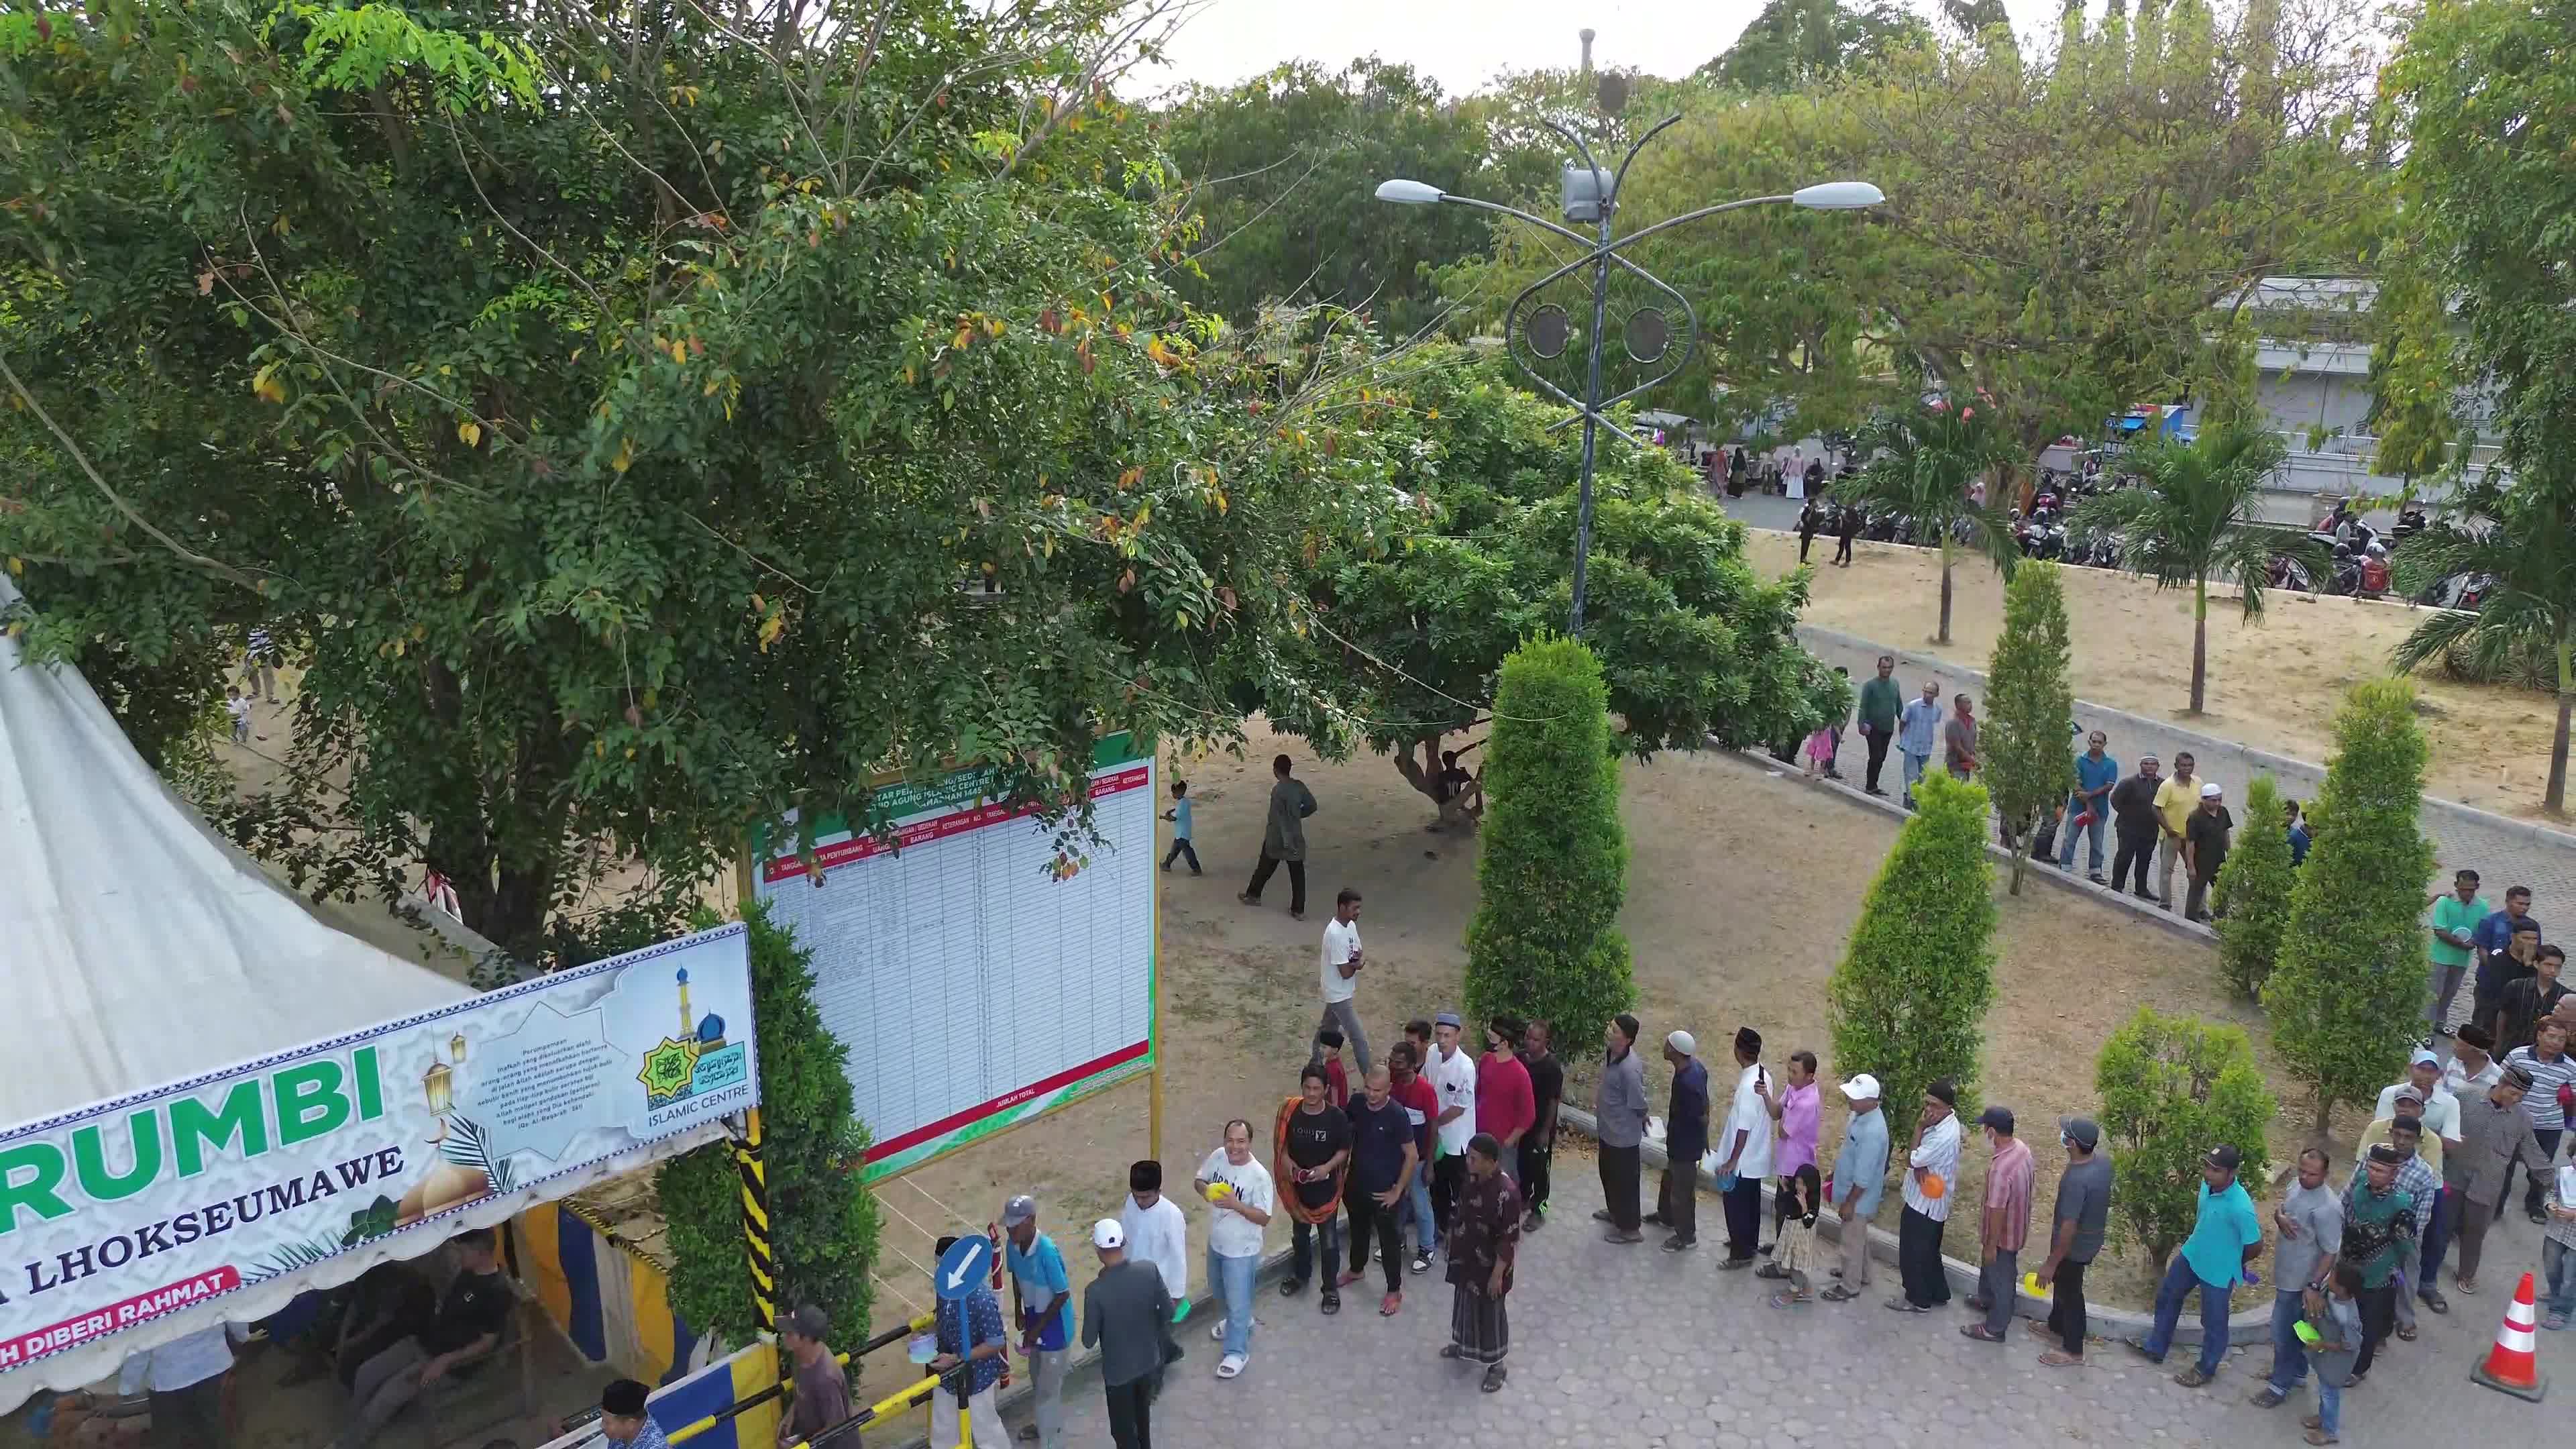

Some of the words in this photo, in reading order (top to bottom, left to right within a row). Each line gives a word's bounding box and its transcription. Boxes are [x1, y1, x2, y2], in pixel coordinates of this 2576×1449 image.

[924, 786, 957, 800] ISLIC
[959, 776, 989, 790] CENTRE
[965, 786, 982, 797] 1445
[910, 832, 934, 843] BARANG
[649, 1101, 698, 1128] ISLAMIC
[701, 1084, 749, 1108] CENTRE
[1019, 1088, 1036, 1099] TOTAL
[0, 1046, 384, 1232] RUMBI
[25, 1145, 405, 1295] LHOKSEUMAWE
[26, 1316, 113, 1356] DIBERI
[119, 1273, 225, 1322] RAHMAT
